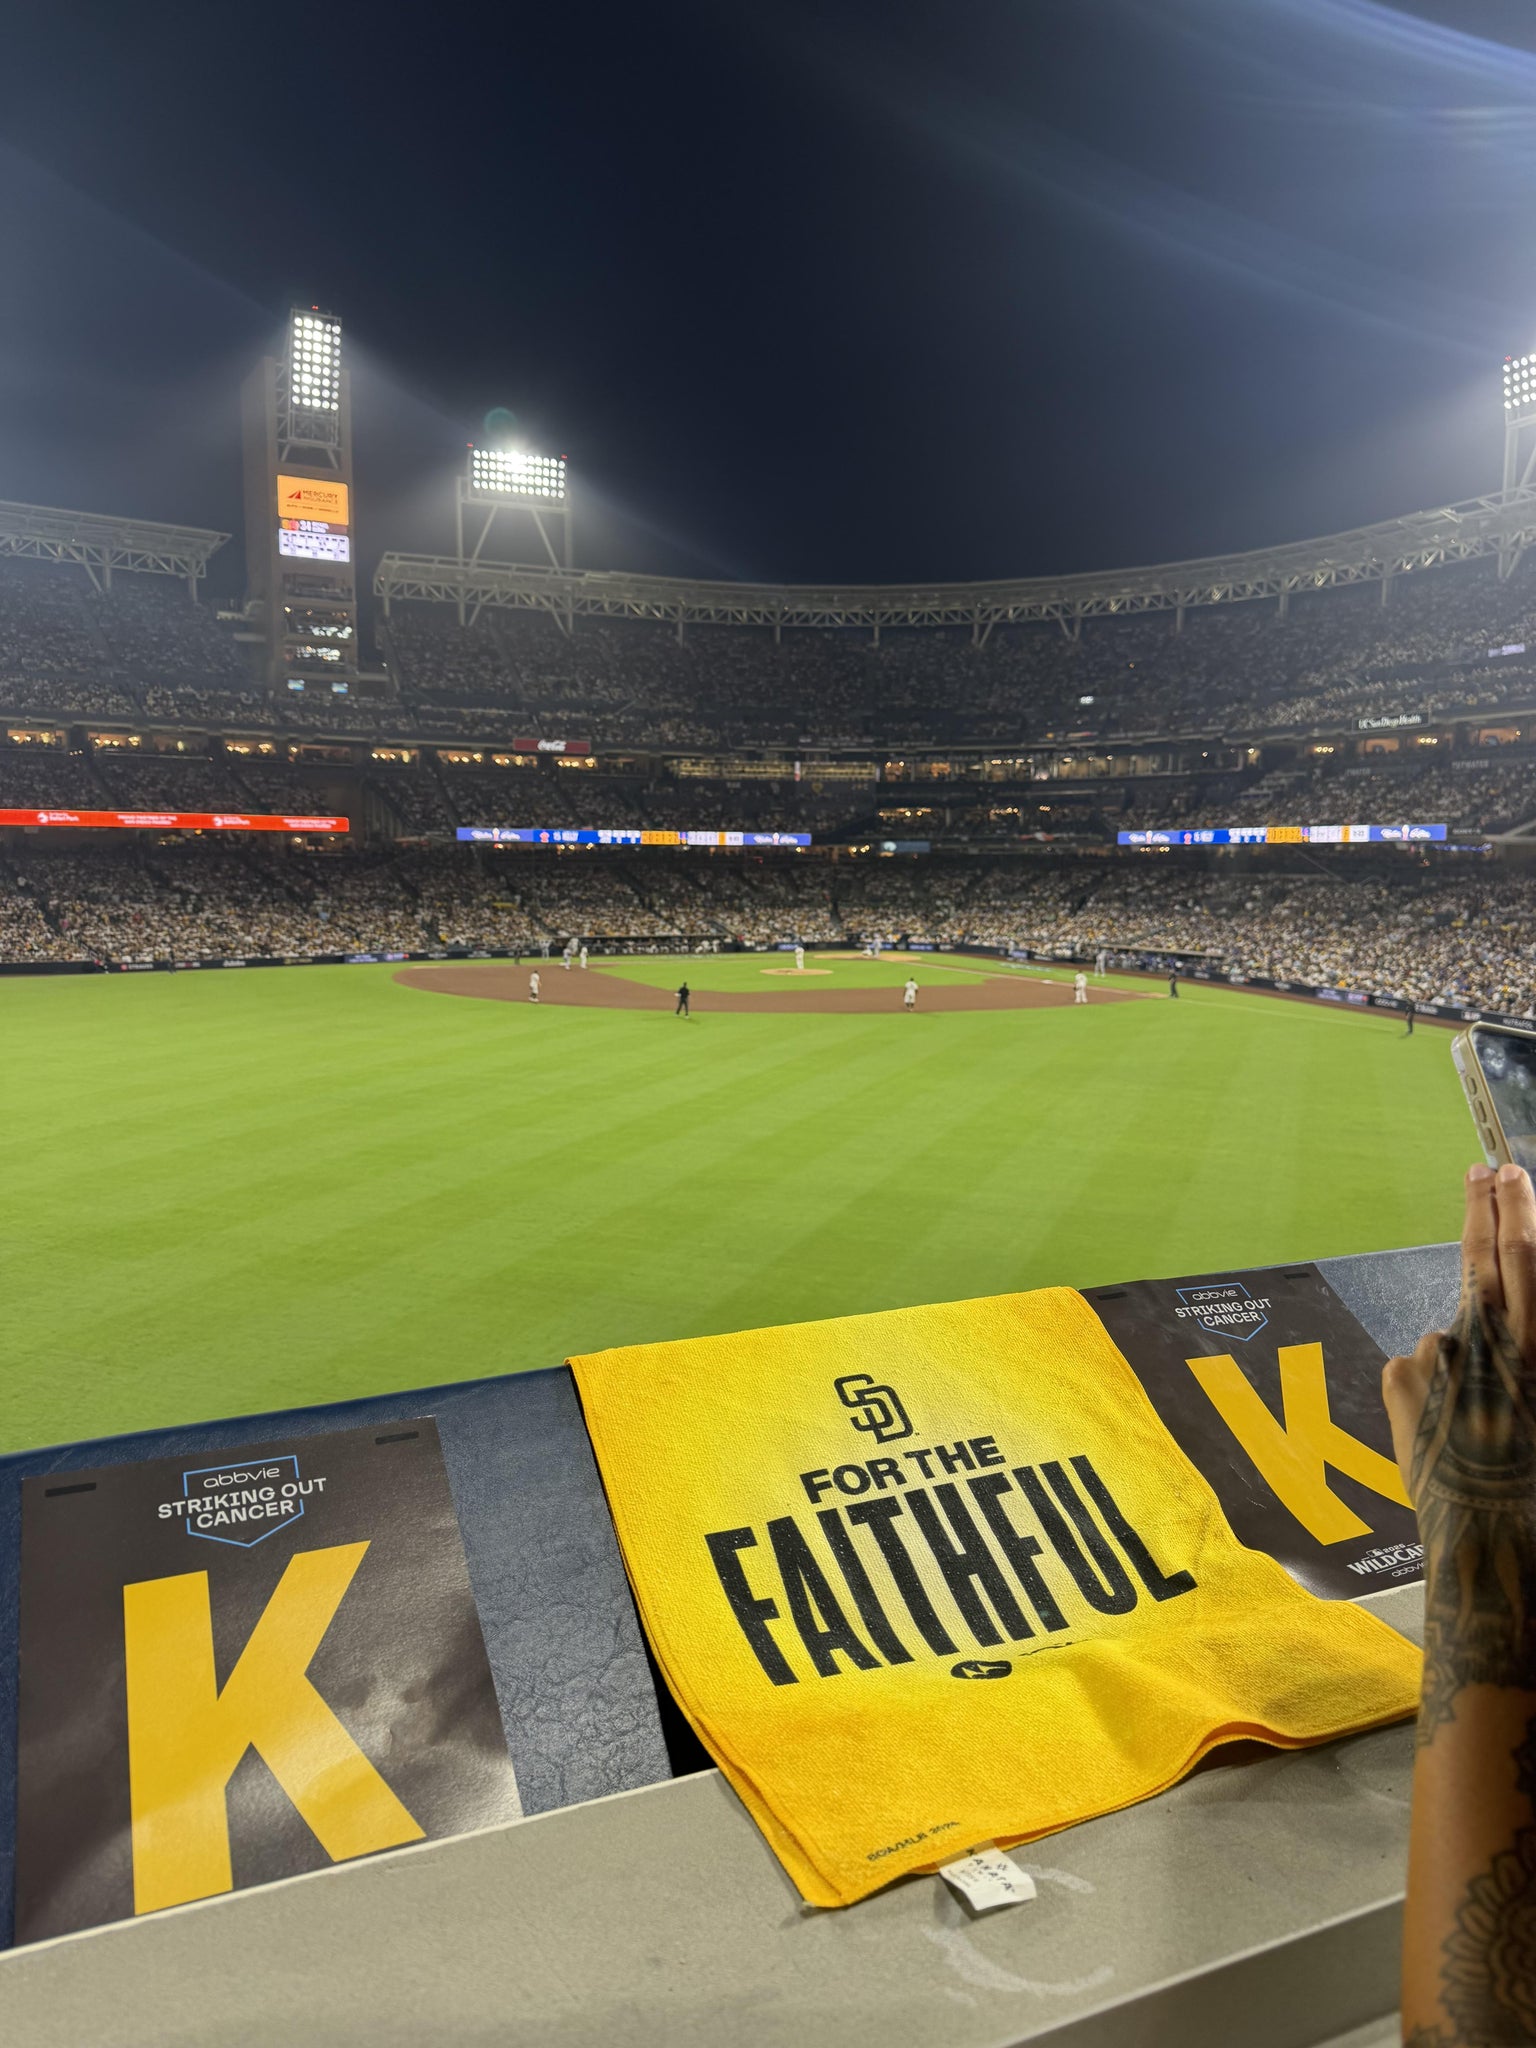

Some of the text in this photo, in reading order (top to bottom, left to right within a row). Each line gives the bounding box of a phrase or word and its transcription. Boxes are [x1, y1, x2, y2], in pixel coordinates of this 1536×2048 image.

[1175, 1298, 1272, 1318] STRIKING OUT
[1192, 1288, 1238, 1301] abbvie
[1203, 1312, 1262, 1327] CANCER
[833, 1373, 914, 1444] SD
[1185, 1341, 1416, 1546] K
[203, 1467, 281, 1489] abbvie
[799, 1435, 1007, 1504] FOR THE
[158, 1477, 327, 1520] STRIKING OUT
[196, 1500, 295, 1529] CANCER
[704, 1454, 1198, 1686] FAITHFUL
[1347, 1543, 1425, 1575] WILDCAR
[1391, 1561, 1425, 1578] abbvi
[123, 1540, 427, 1916] K
